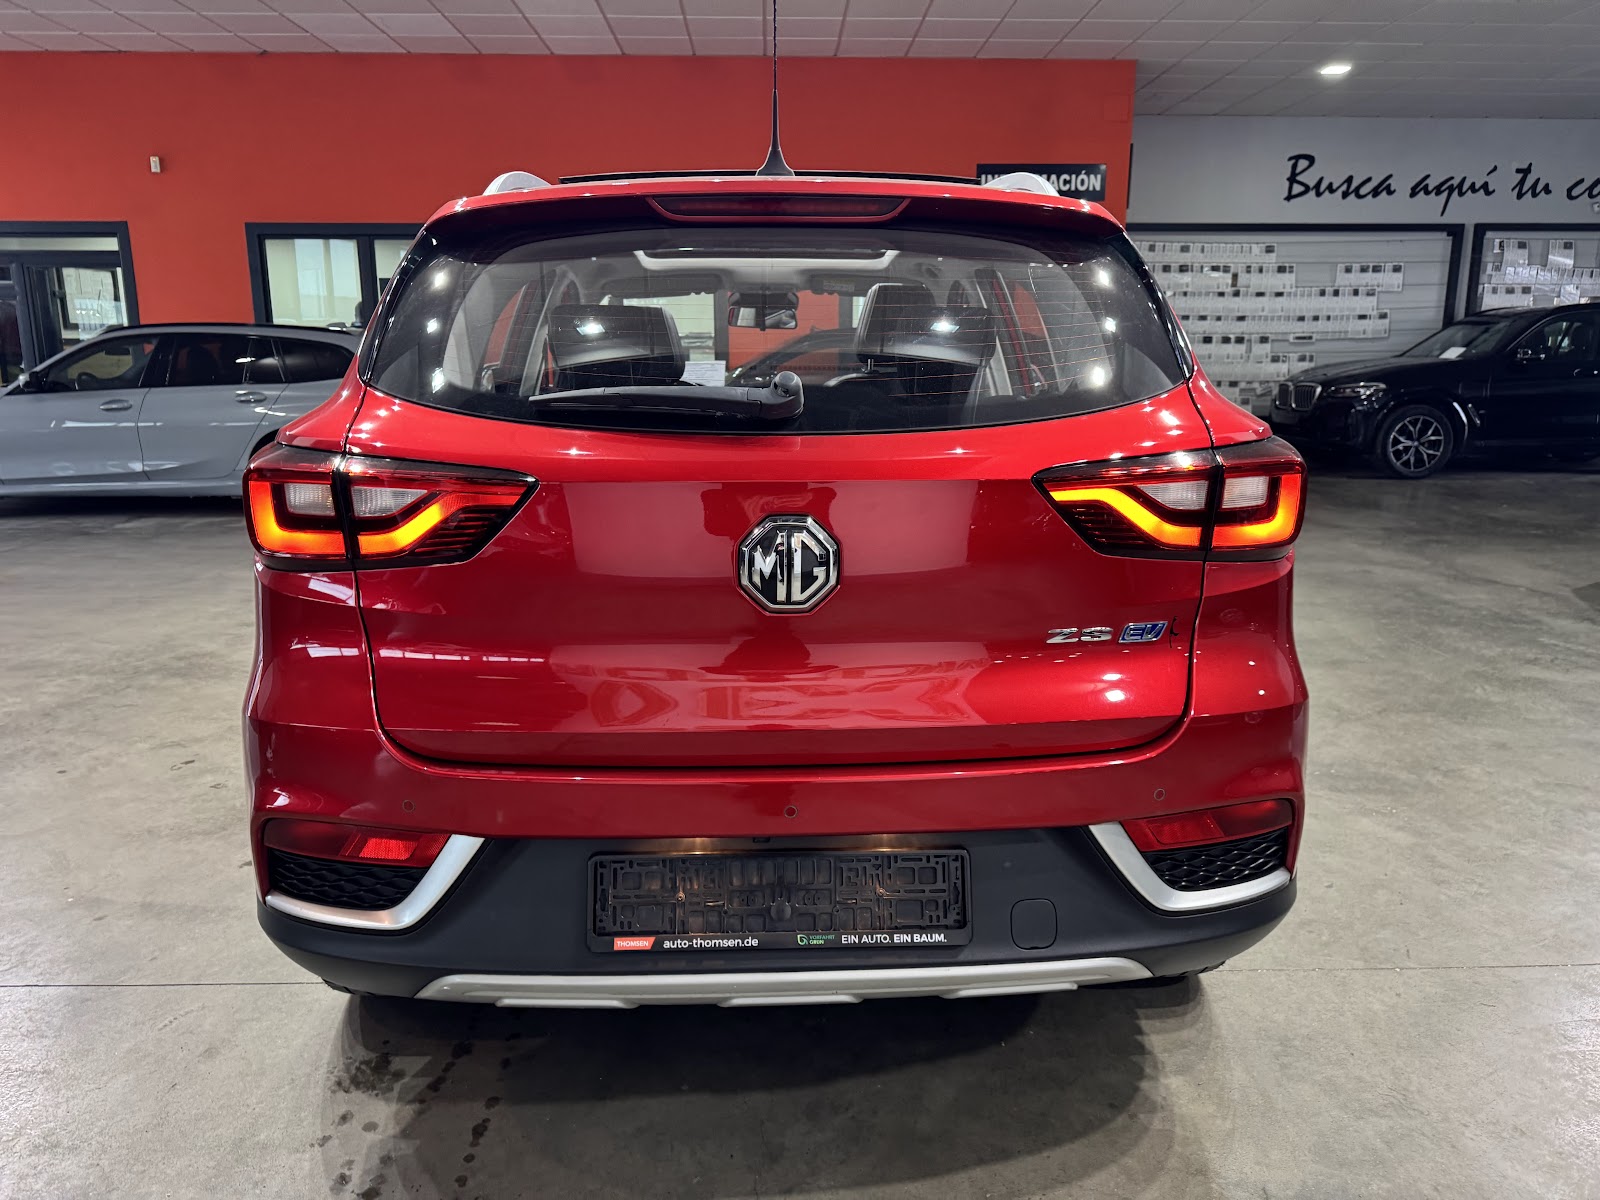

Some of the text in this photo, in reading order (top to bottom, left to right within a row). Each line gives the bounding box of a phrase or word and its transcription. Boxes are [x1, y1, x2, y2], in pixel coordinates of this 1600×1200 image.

[1283, 153, 1396, 202] Busca
[1409, 165, 1498, 217] aquí
[1511, 162, 1552, 200] tu
[751, 529, 828, 603] MG
[1046, 623, 1164, 644] ZS EV
[616, 940, 649, 948] THOMSEN
[663, 936, 759, 949] auto-thomsen.de
[841, 933, 947, 944] EIN AUTO. EIN BAUM.
